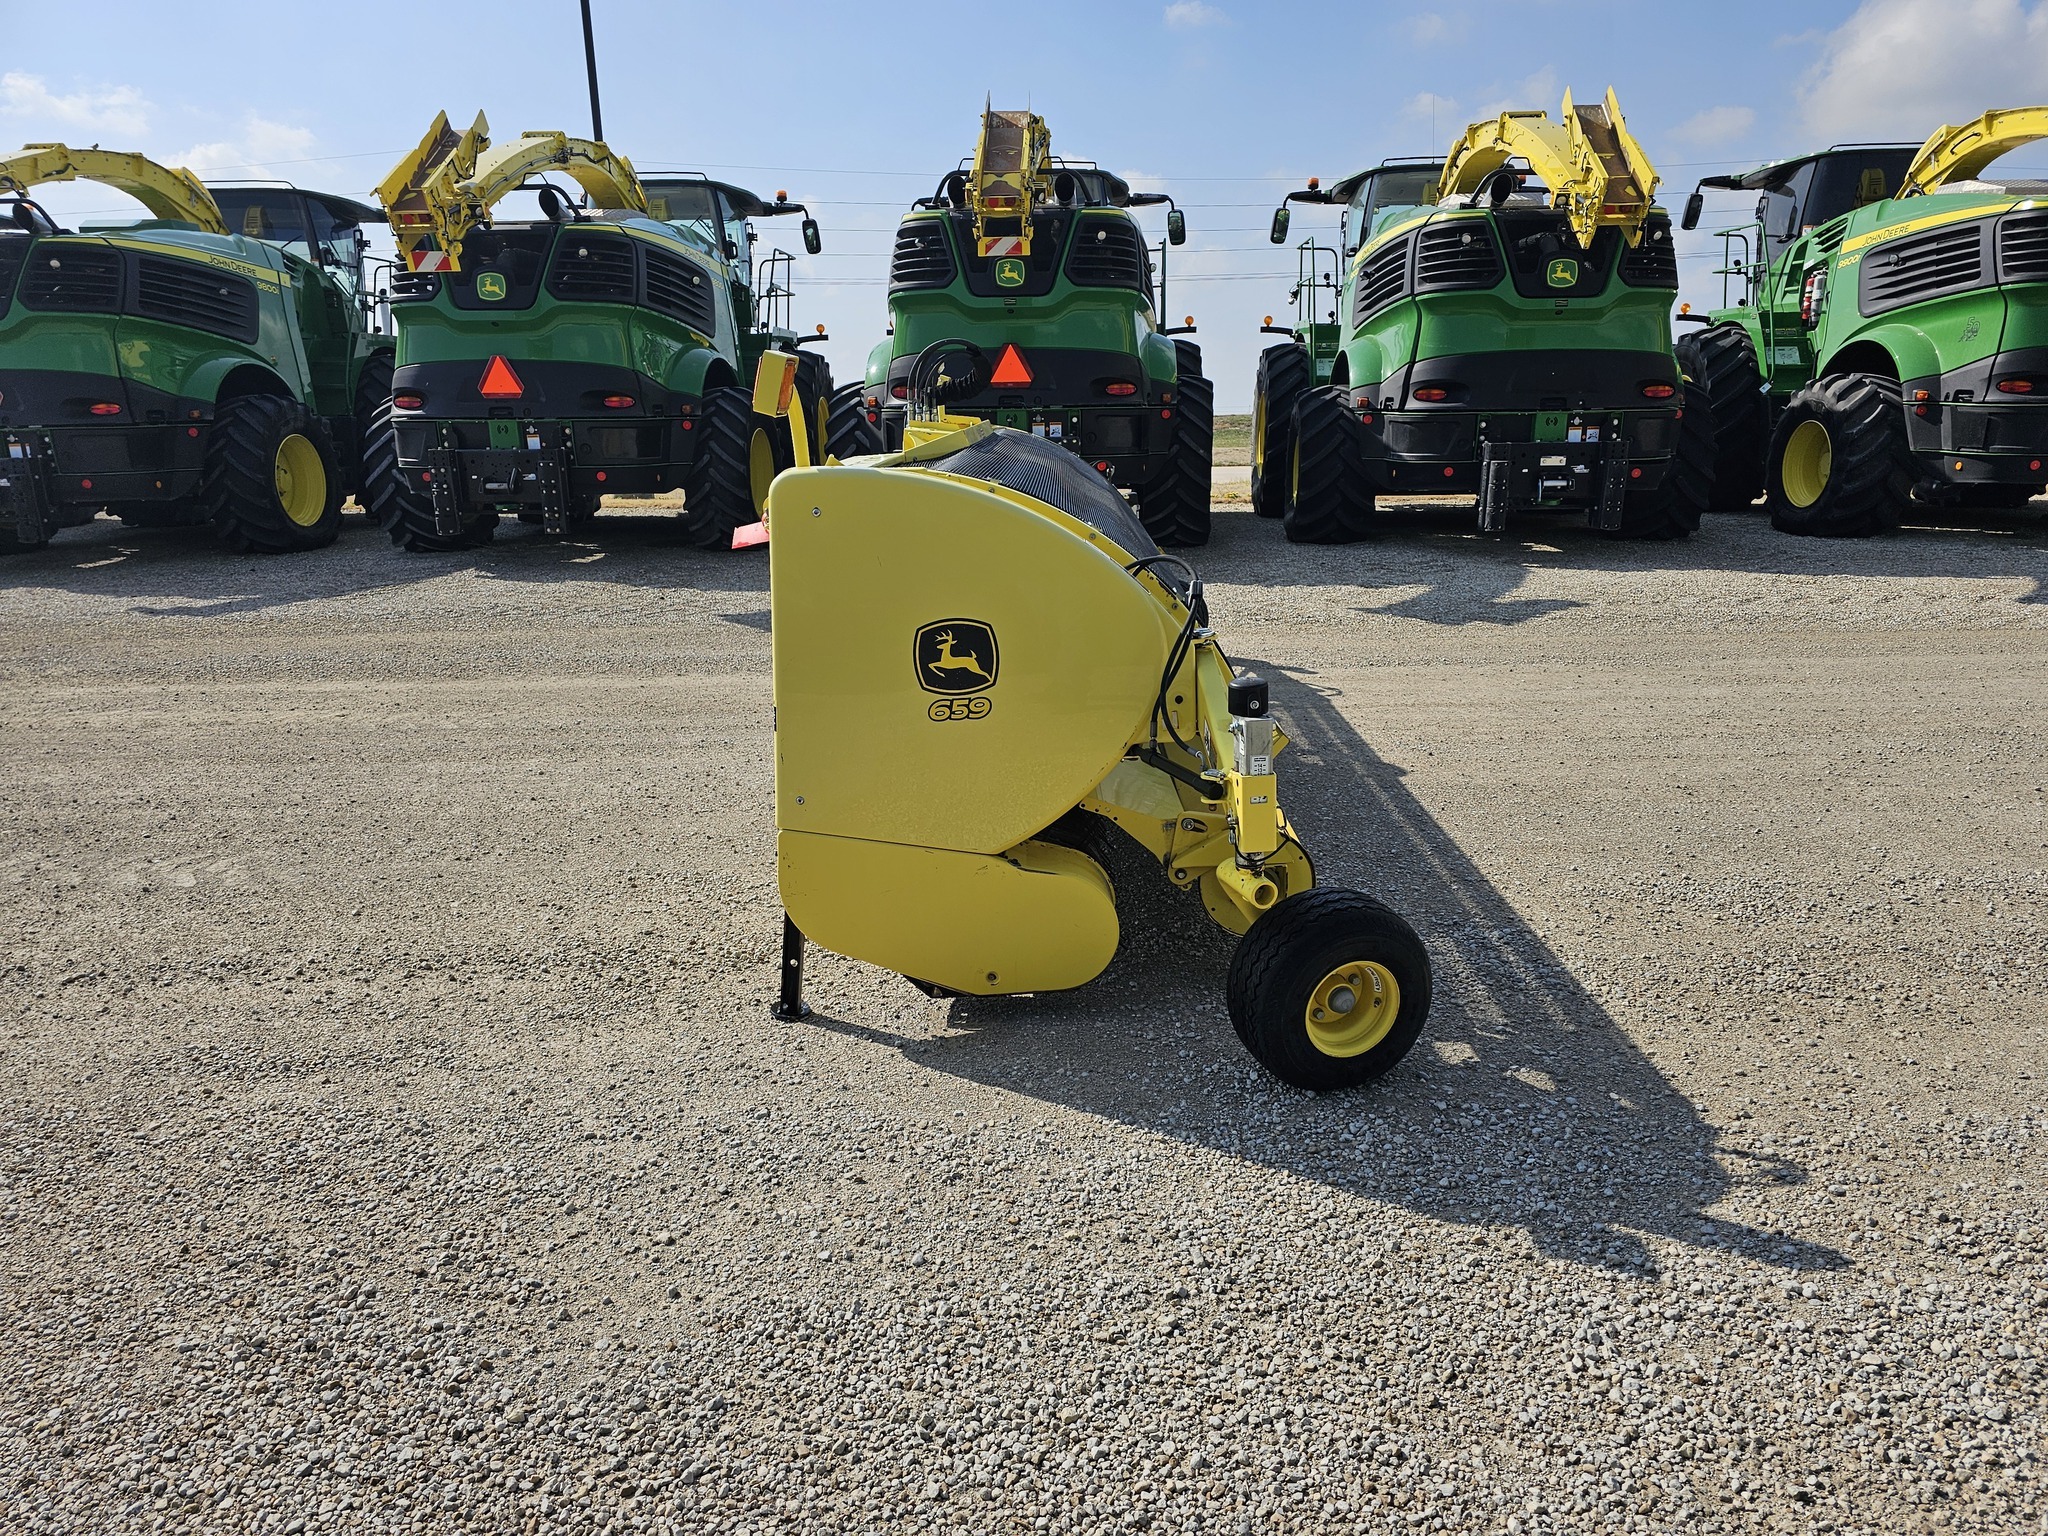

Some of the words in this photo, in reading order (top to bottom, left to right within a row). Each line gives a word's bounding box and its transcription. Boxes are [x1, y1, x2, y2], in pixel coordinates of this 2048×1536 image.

[1883, 224, 1911, 240] DEERE
[208, 255, 232, 269] JOHN
[231, 260, 258, 277] DEERE
[928, 696, 992, 722] 659
